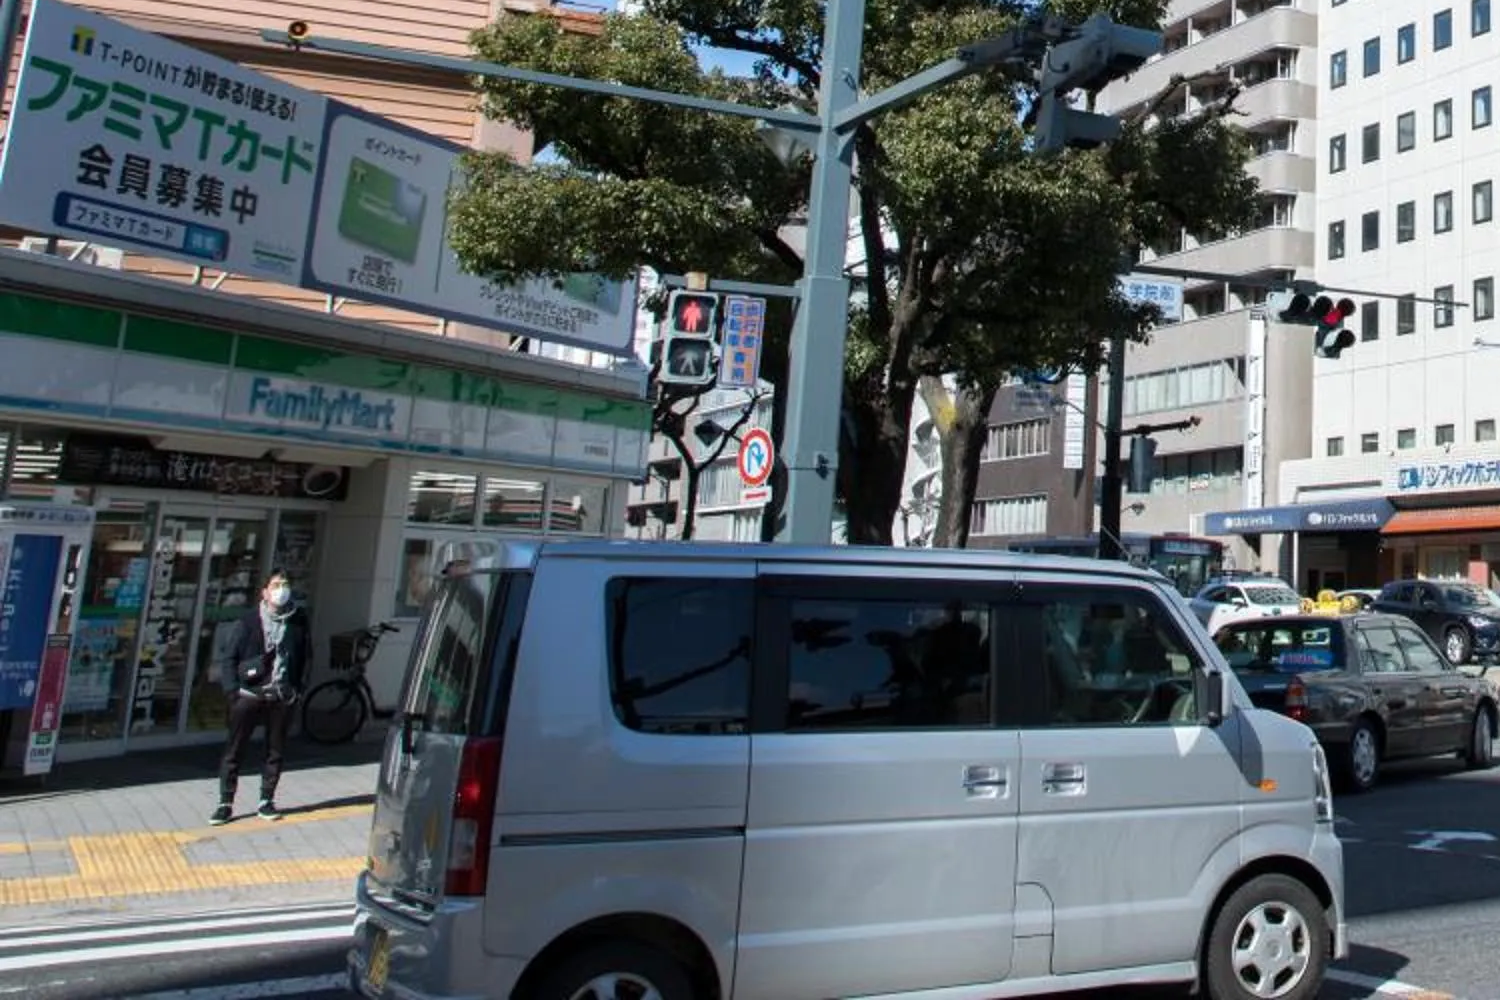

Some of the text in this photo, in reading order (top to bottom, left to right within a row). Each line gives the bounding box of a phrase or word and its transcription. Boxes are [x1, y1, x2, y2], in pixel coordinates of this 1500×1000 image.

[27, 55, 315, 185] ファミマTカード
[76, 143, 259, 225] 会員募集中
[73, 204, 178, 241] ファミマTカード
[248, 377, 397, 433] FamilyMart
